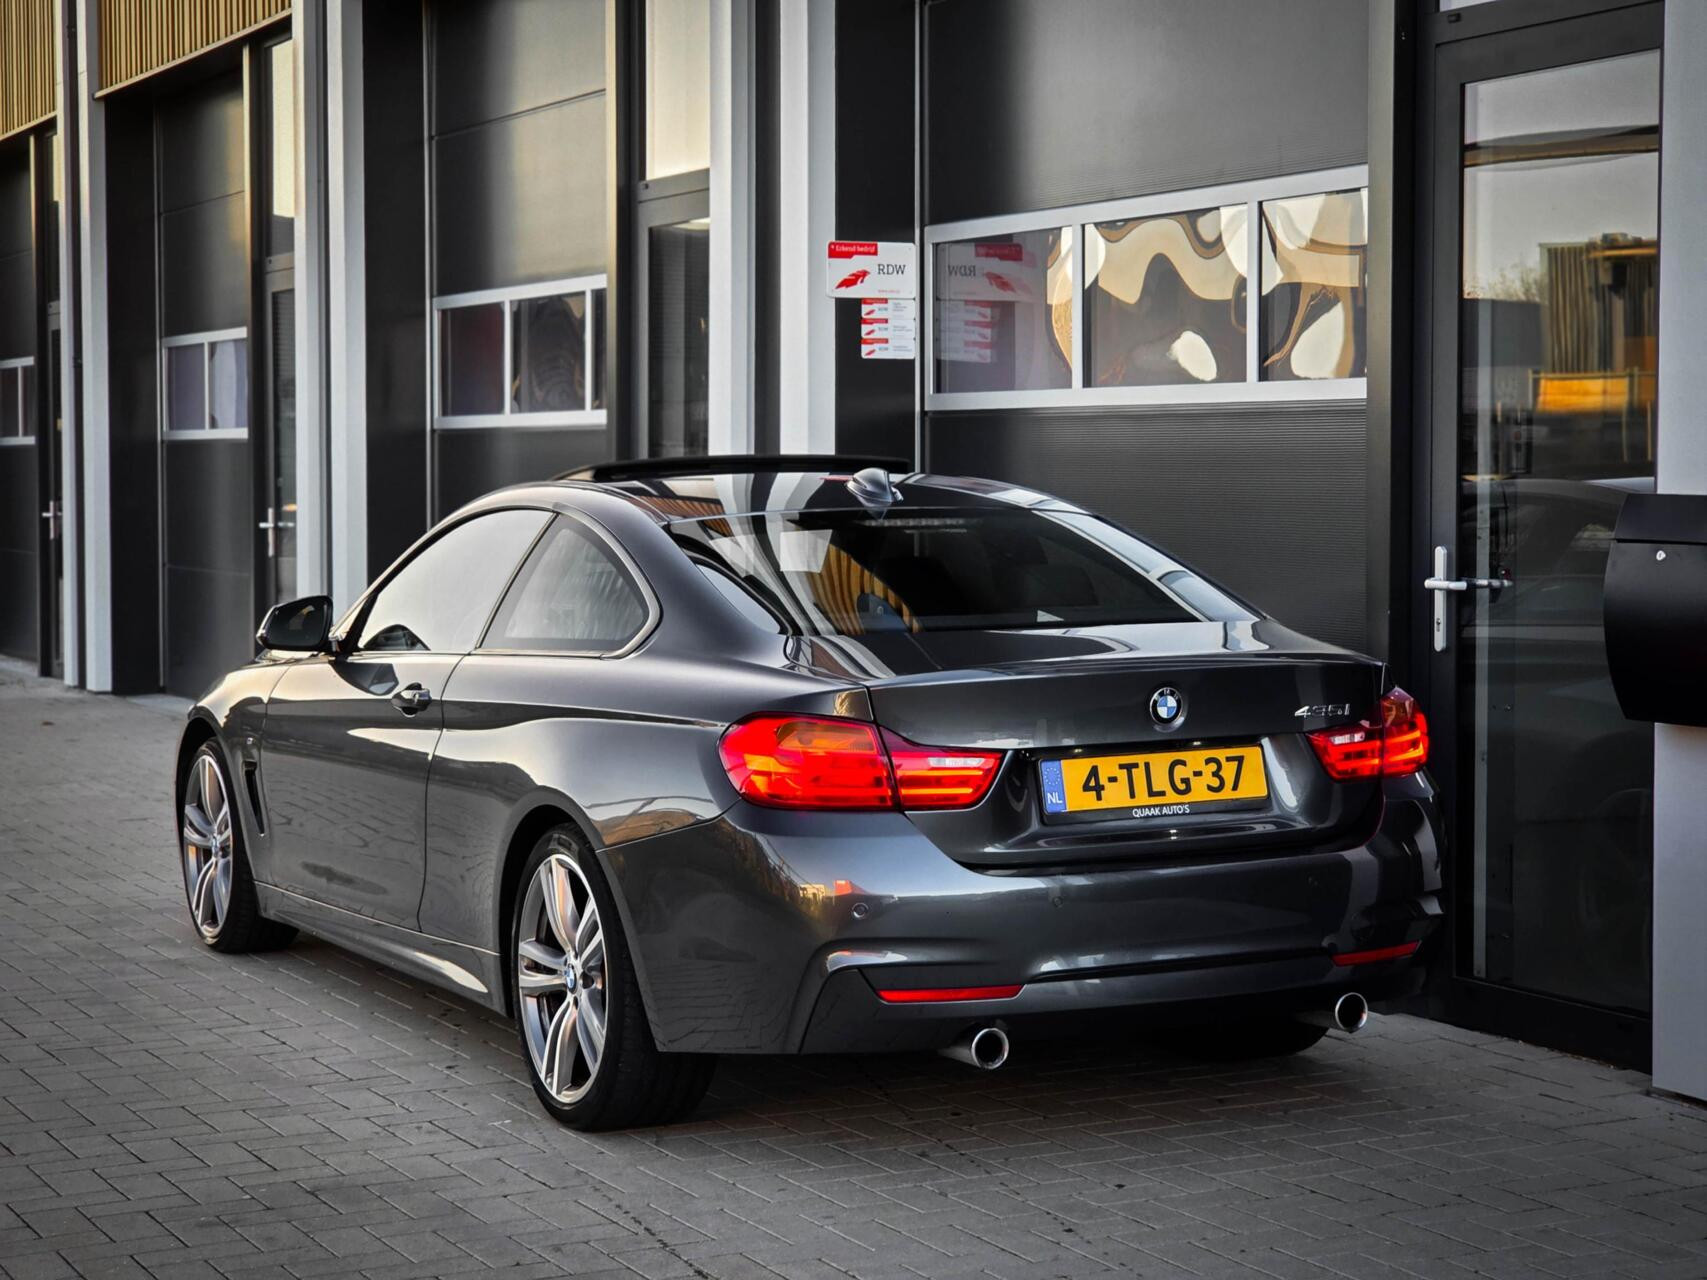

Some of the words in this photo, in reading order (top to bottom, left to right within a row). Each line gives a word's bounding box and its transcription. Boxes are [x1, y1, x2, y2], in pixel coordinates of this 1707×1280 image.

[877, 263, 906, 276] RDW
[1082, 755, 1245, 802] 4-TLG-37
[1047, 792, 1063, 804] NL
[1132, 806, 1161, 818] QUAAK
[1161, 804, 1190, 815] AUTO'S
